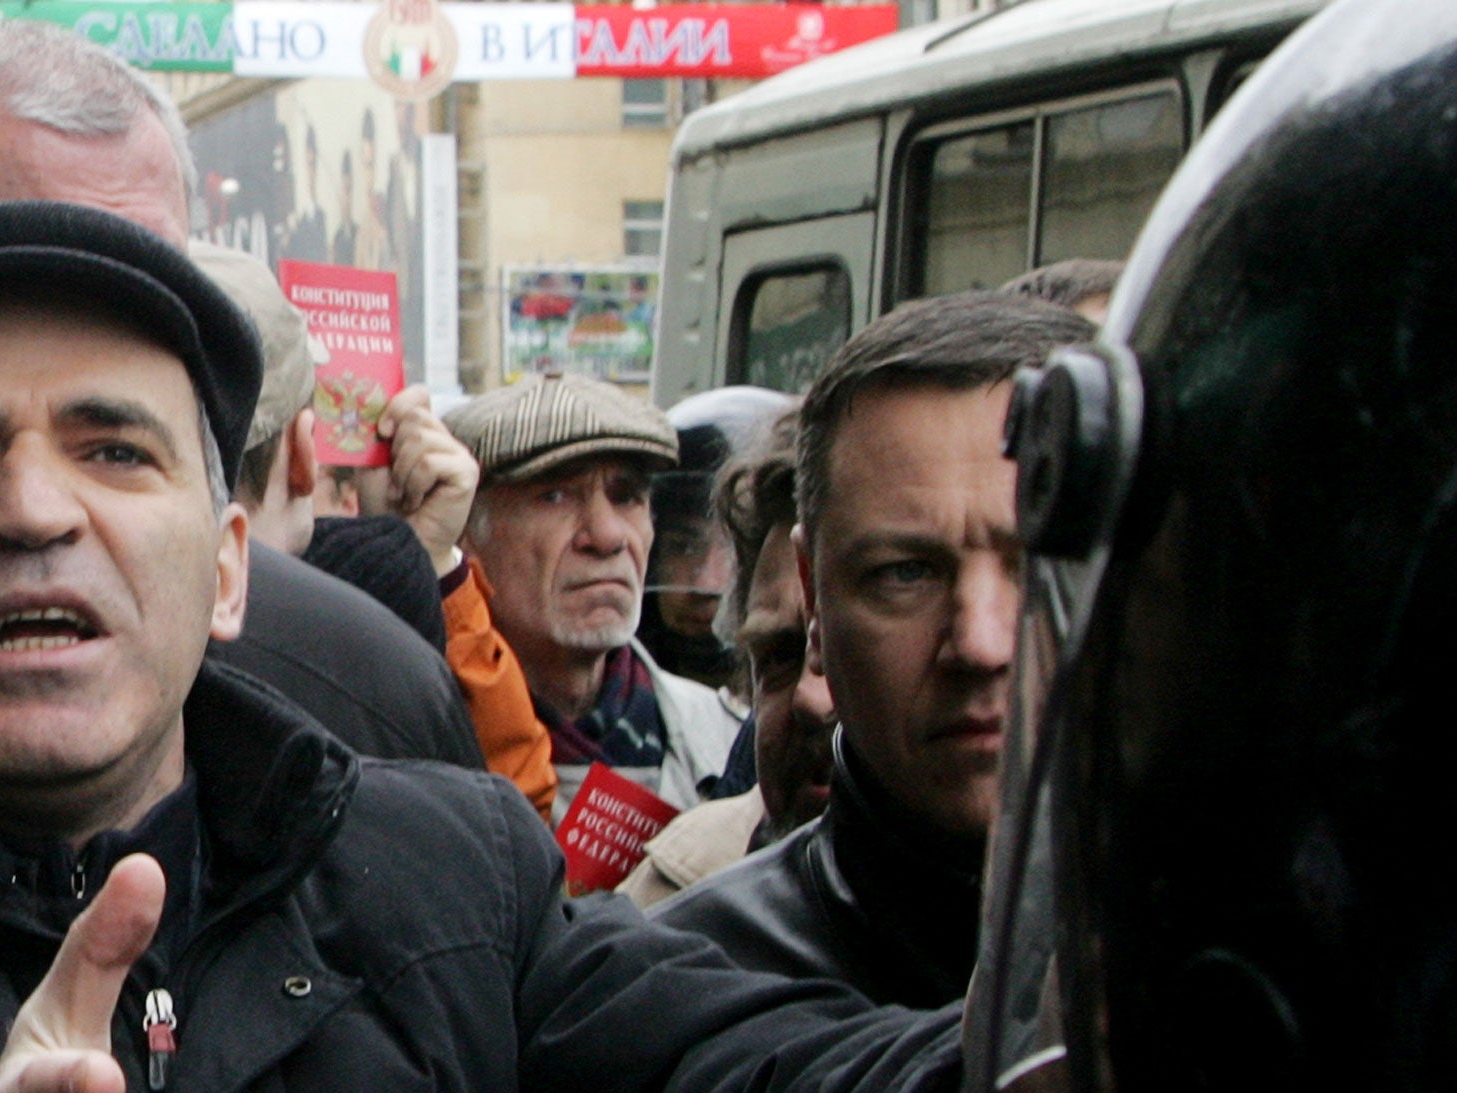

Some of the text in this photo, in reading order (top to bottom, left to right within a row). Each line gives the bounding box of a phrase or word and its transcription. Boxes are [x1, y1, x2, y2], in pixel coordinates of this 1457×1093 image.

[74, 10, 327, 66] СДЕЛАНО
[480, 21, 506, 63] В
[522, 17, 733, 67] ИТАЛИИ
[290, 284, 390, 311] КОНСТИТУЦИЯ
